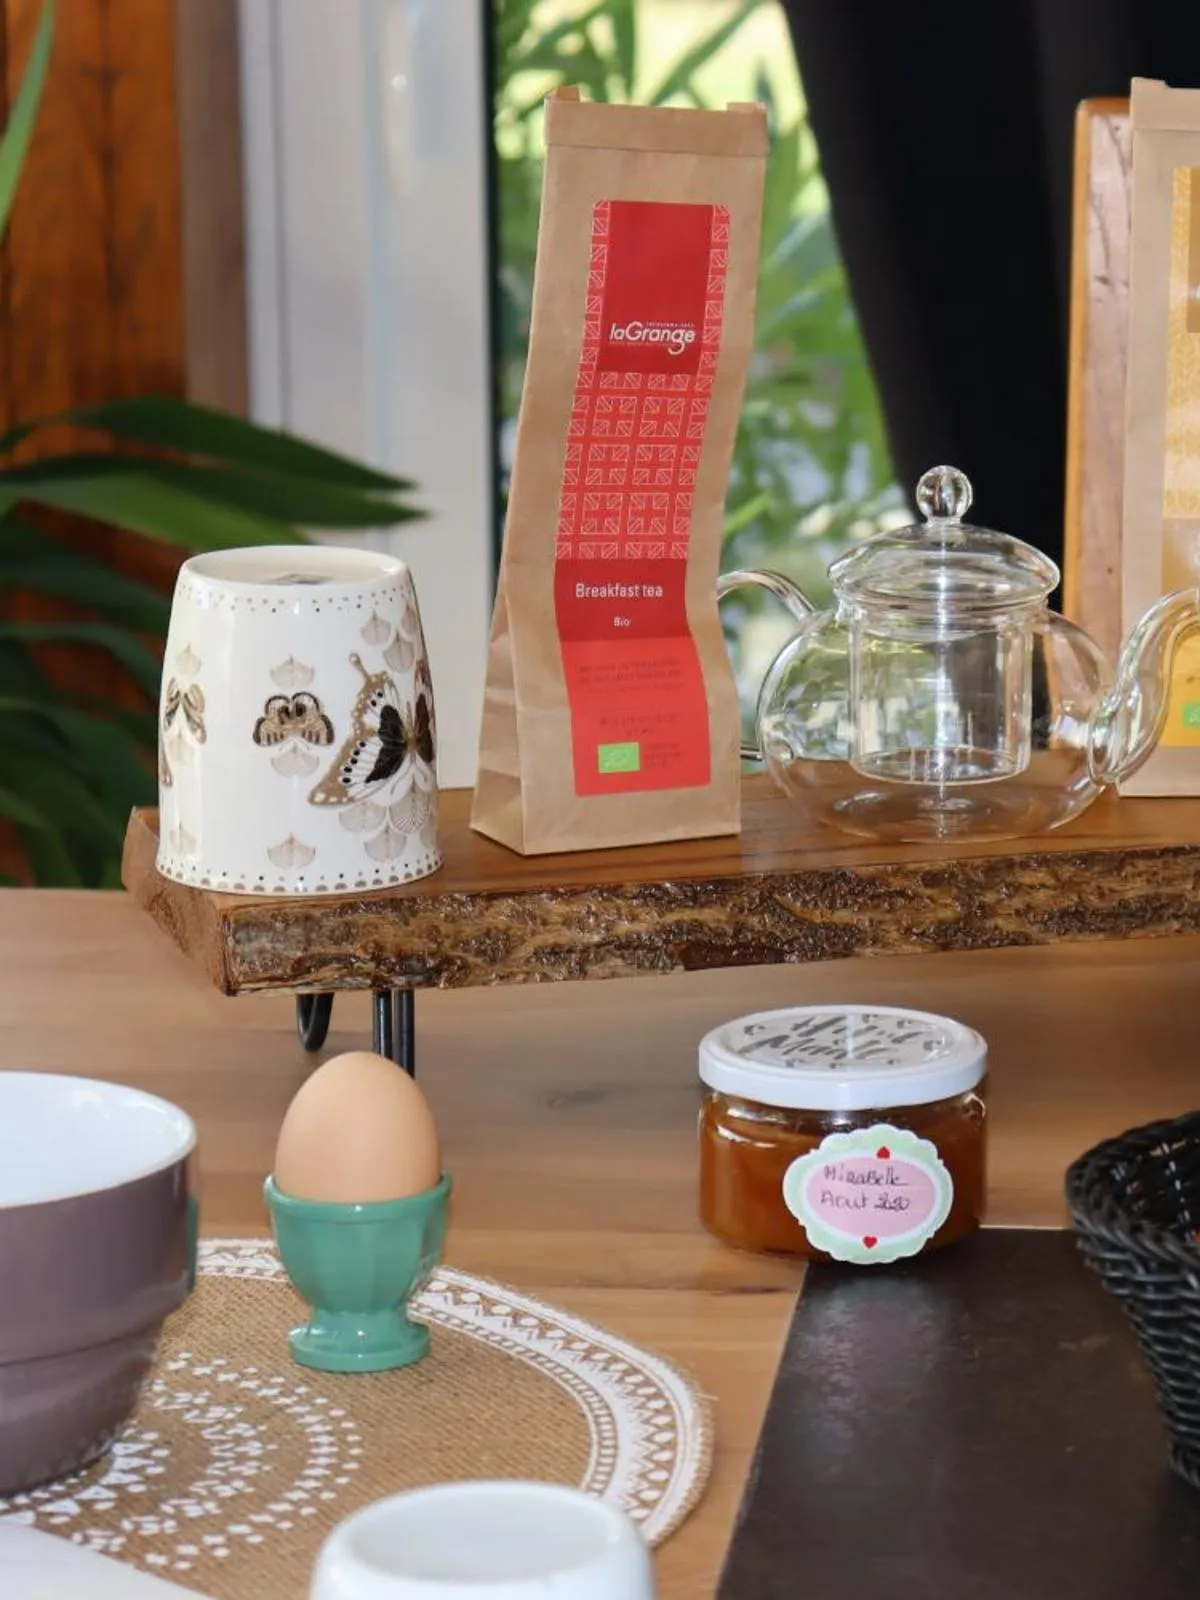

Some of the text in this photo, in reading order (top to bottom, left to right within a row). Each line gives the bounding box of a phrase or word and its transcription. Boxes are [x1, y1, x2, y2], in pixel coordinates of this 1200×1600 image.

[608, 320, 696, 355] laGrange
[574, 582, 663, 598] Breakfast tea
[613, 616, 631, 627] Bio
